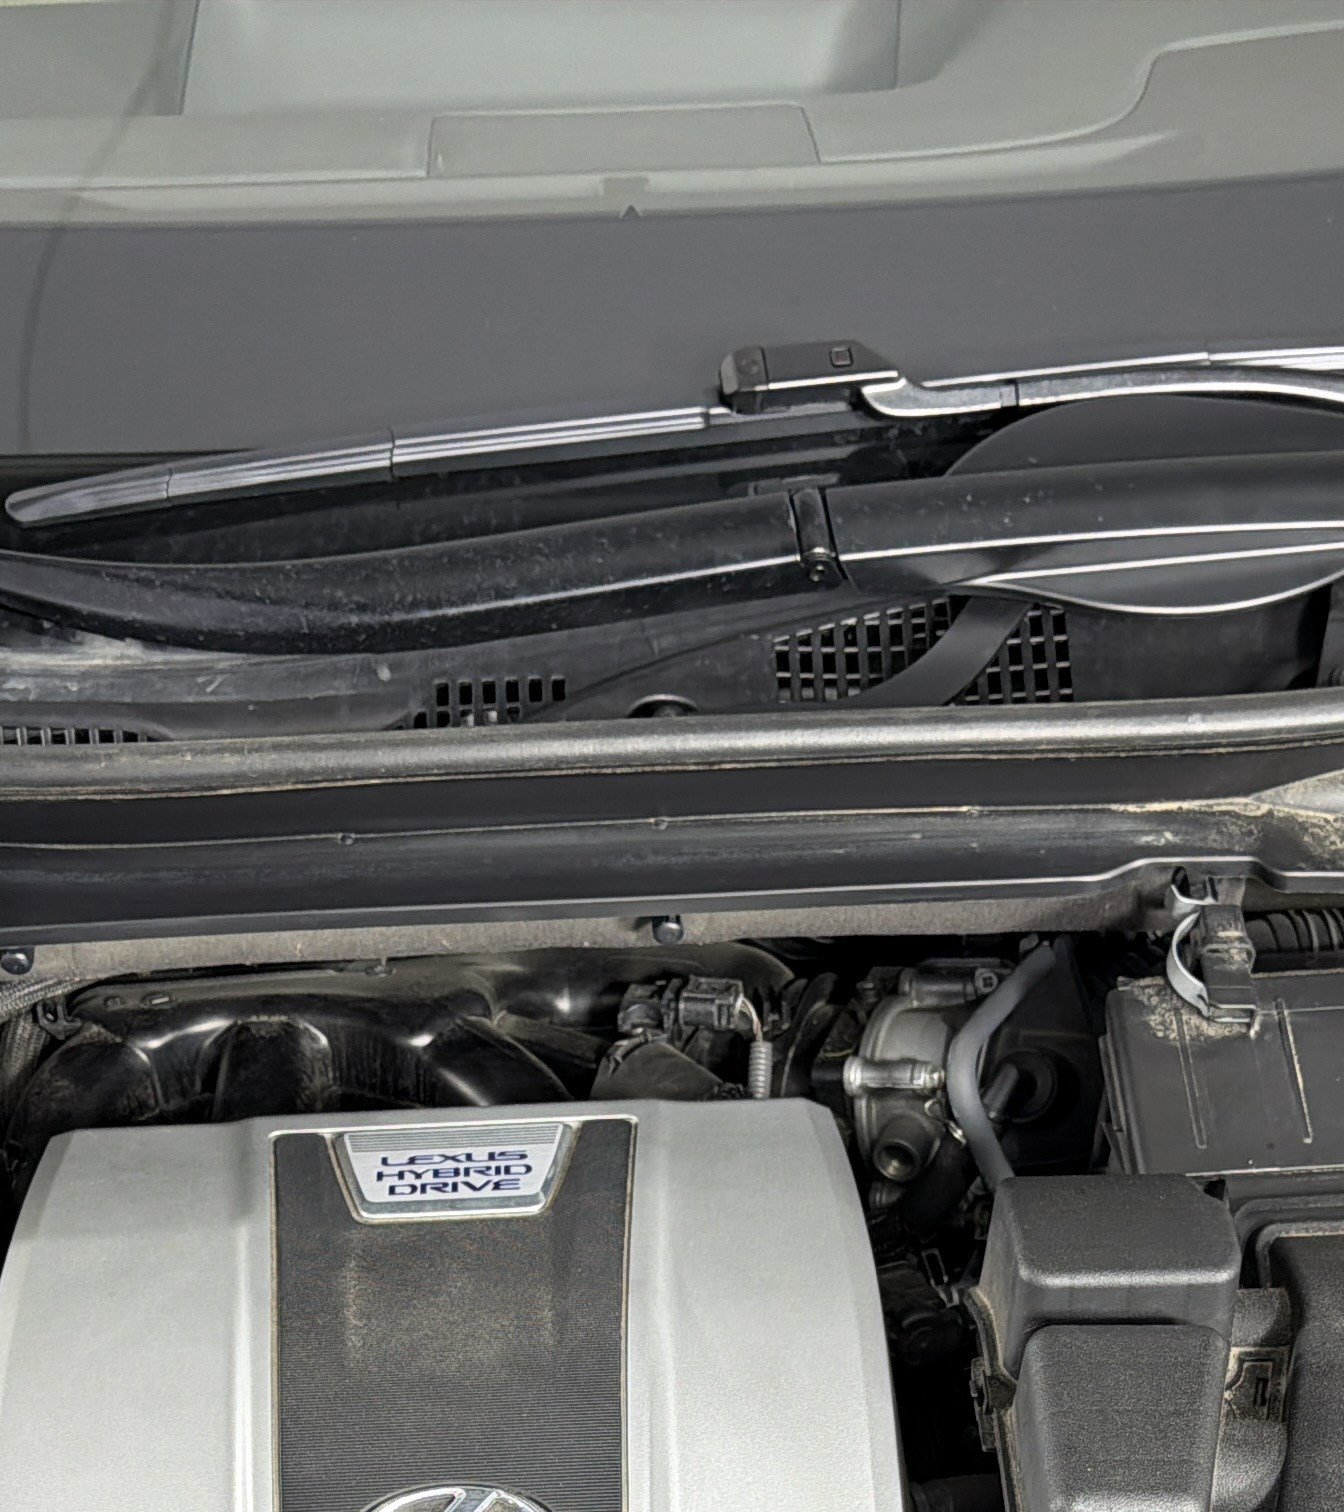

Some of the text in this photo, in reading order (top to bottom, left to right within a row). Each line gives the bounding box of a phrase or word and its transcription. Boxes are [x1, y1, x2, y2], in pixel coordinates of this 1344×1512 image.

[380, 1149, 529, 1167] LEXUS
[375, 1163, 533, 1183] HYBRID
[387, 1178, 522, 1197] DRIVE
